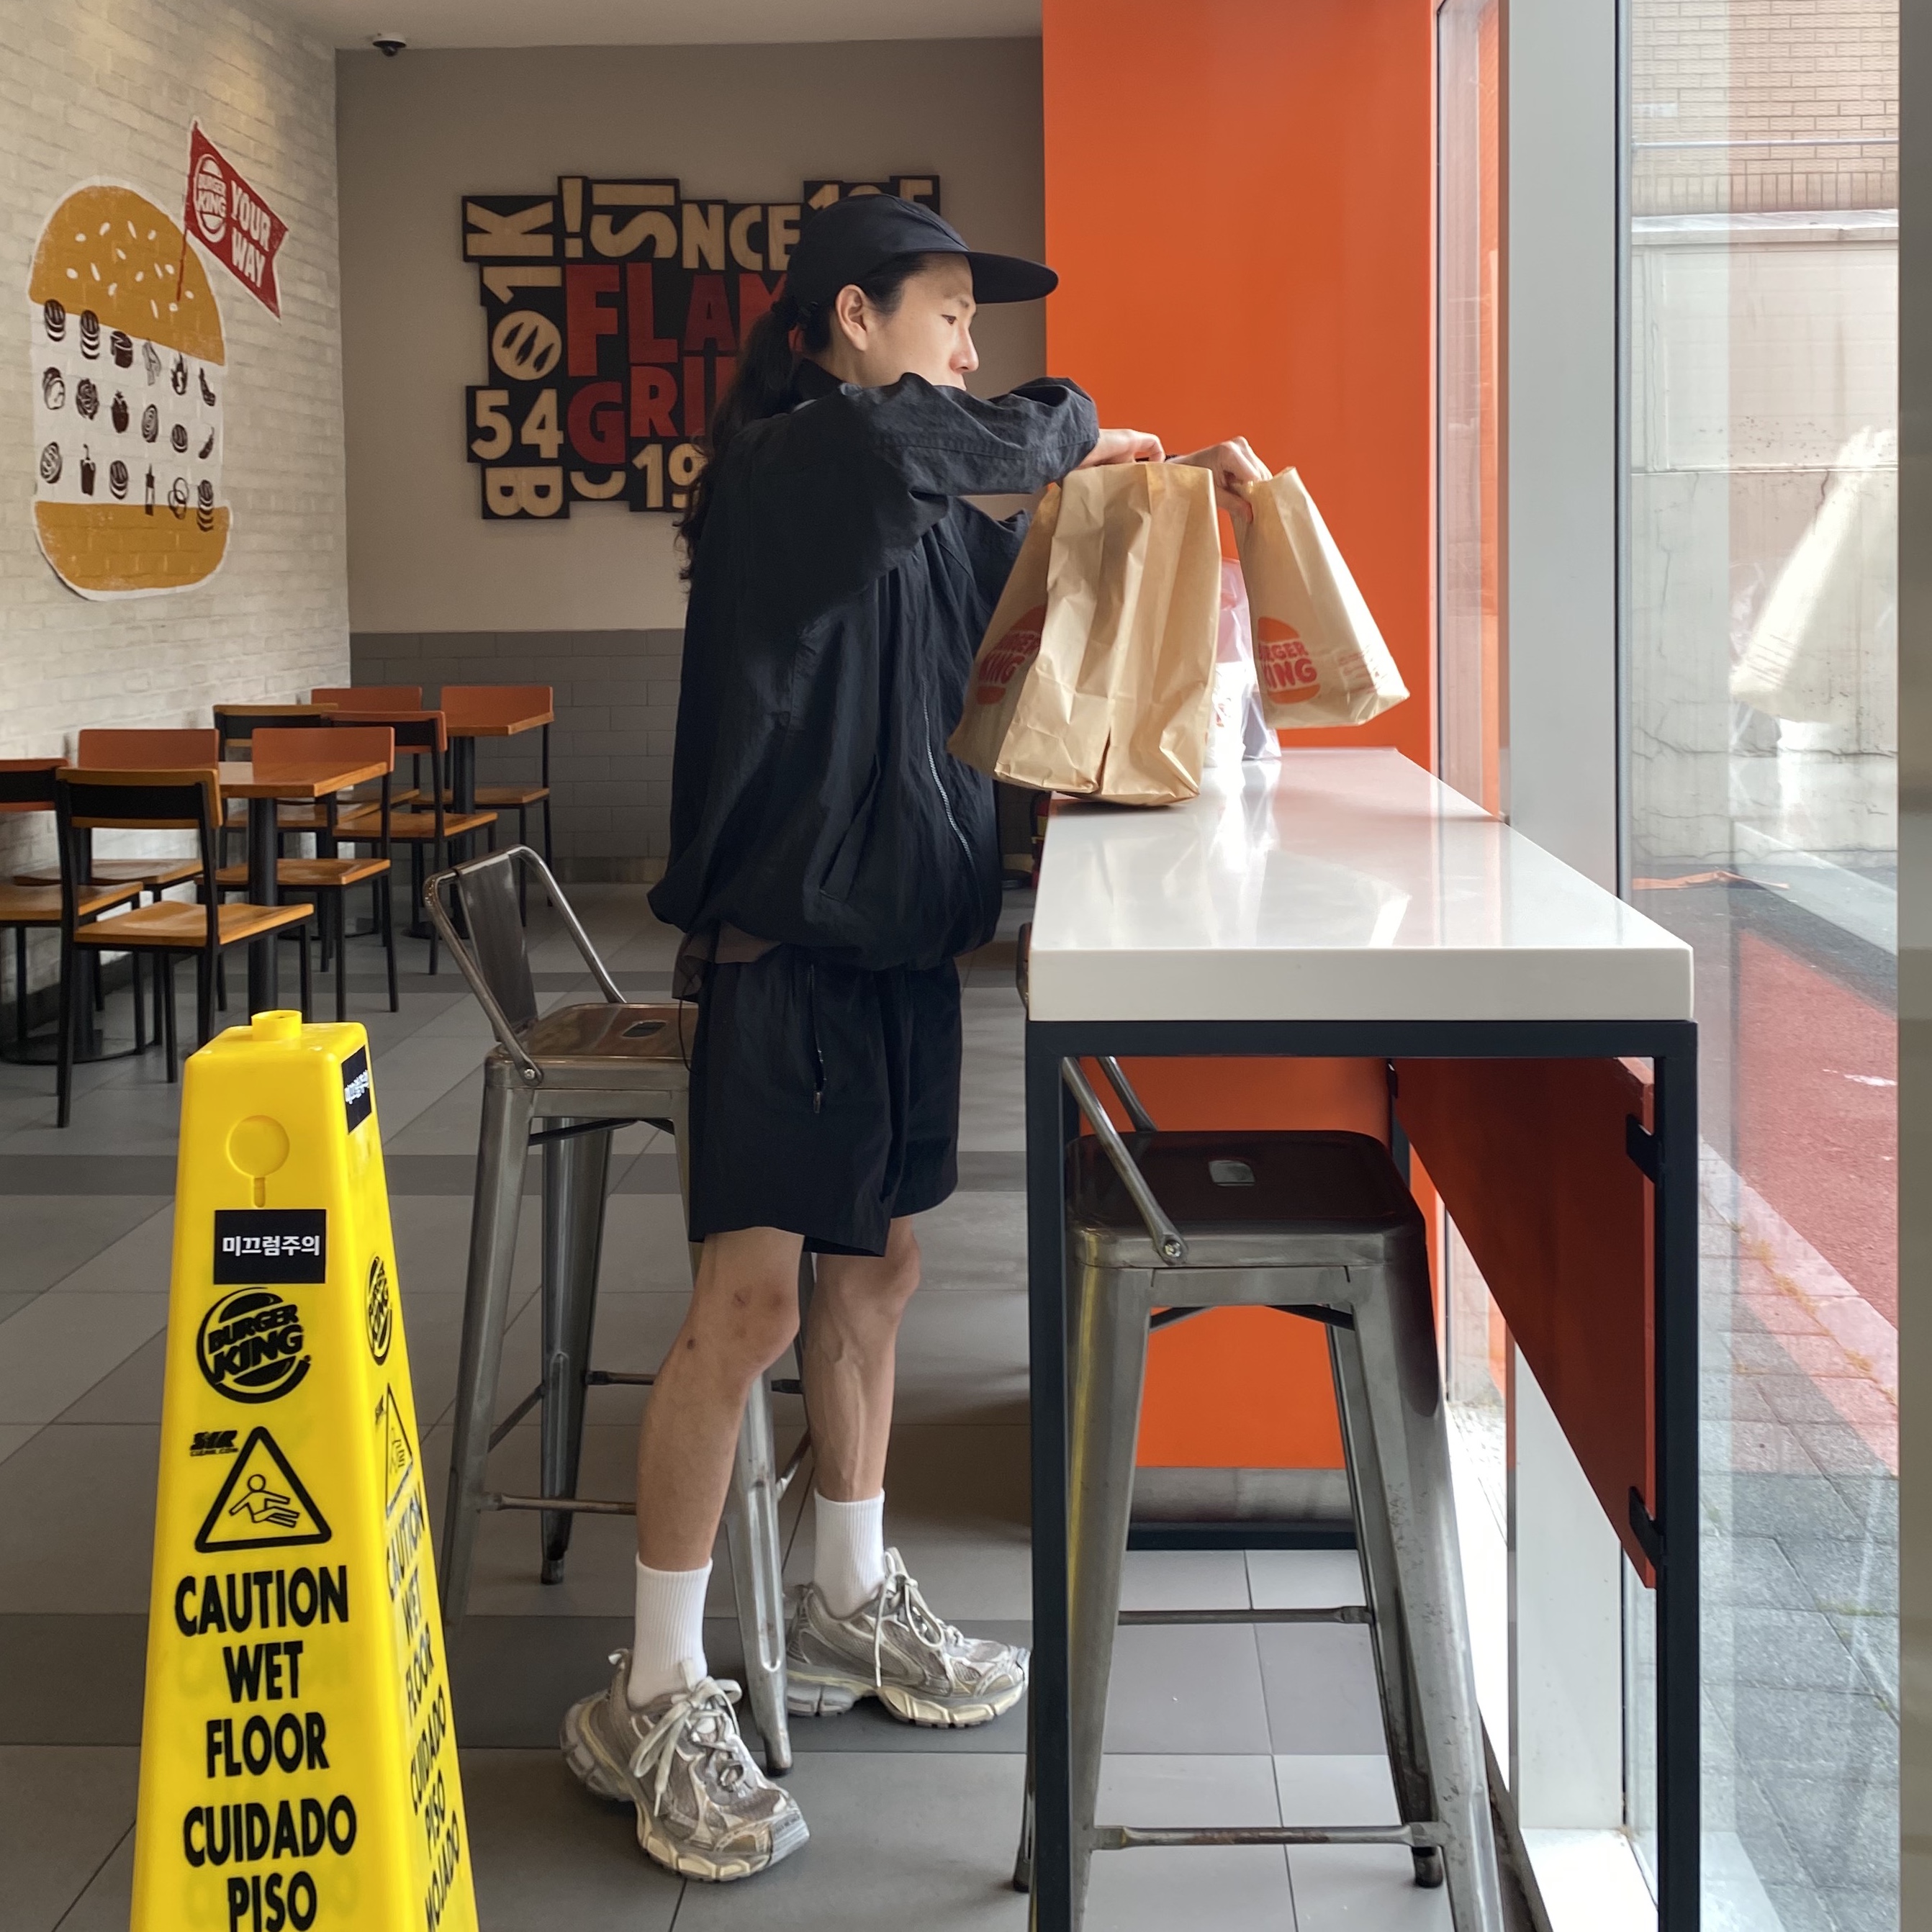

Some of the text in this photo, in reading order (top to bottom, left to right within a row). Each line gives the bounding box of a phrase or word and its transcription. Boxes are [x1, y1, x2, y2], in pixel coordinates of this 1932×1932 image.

[197, 190, 227, 217] KING
[231, 180, 271, 252] YOUR
[232, 227, 265, 288] WAY
[470, 389, 564, 461] 54
[1262, 658, 1317, 689] ING
[222, 1235, 320, 1257] 미끄럼주의
[208, 1304, 299, 1355] BURGER
[214, 1324, 304, 1382] KING
[387, 1480, 425, 1603] CAUTION
[174, 1566, 348, 1637] CAUTION
[402, 1564, 422, 1647] WET
[222, 1640, 304, 1703] WET
[406, 1620, 435, 1728] FLOOR
[206, 1712, 330, 1779] FLOOR
[410, 1684, 447, 1817] CUIDADO
[183, 1795, 357, 1868] CUIDADO
[425, 1769, 446, 1860] PISO
[227, 1871, 317, 1932] PISO
[425, 1810, 460, 1932] MOJADO
